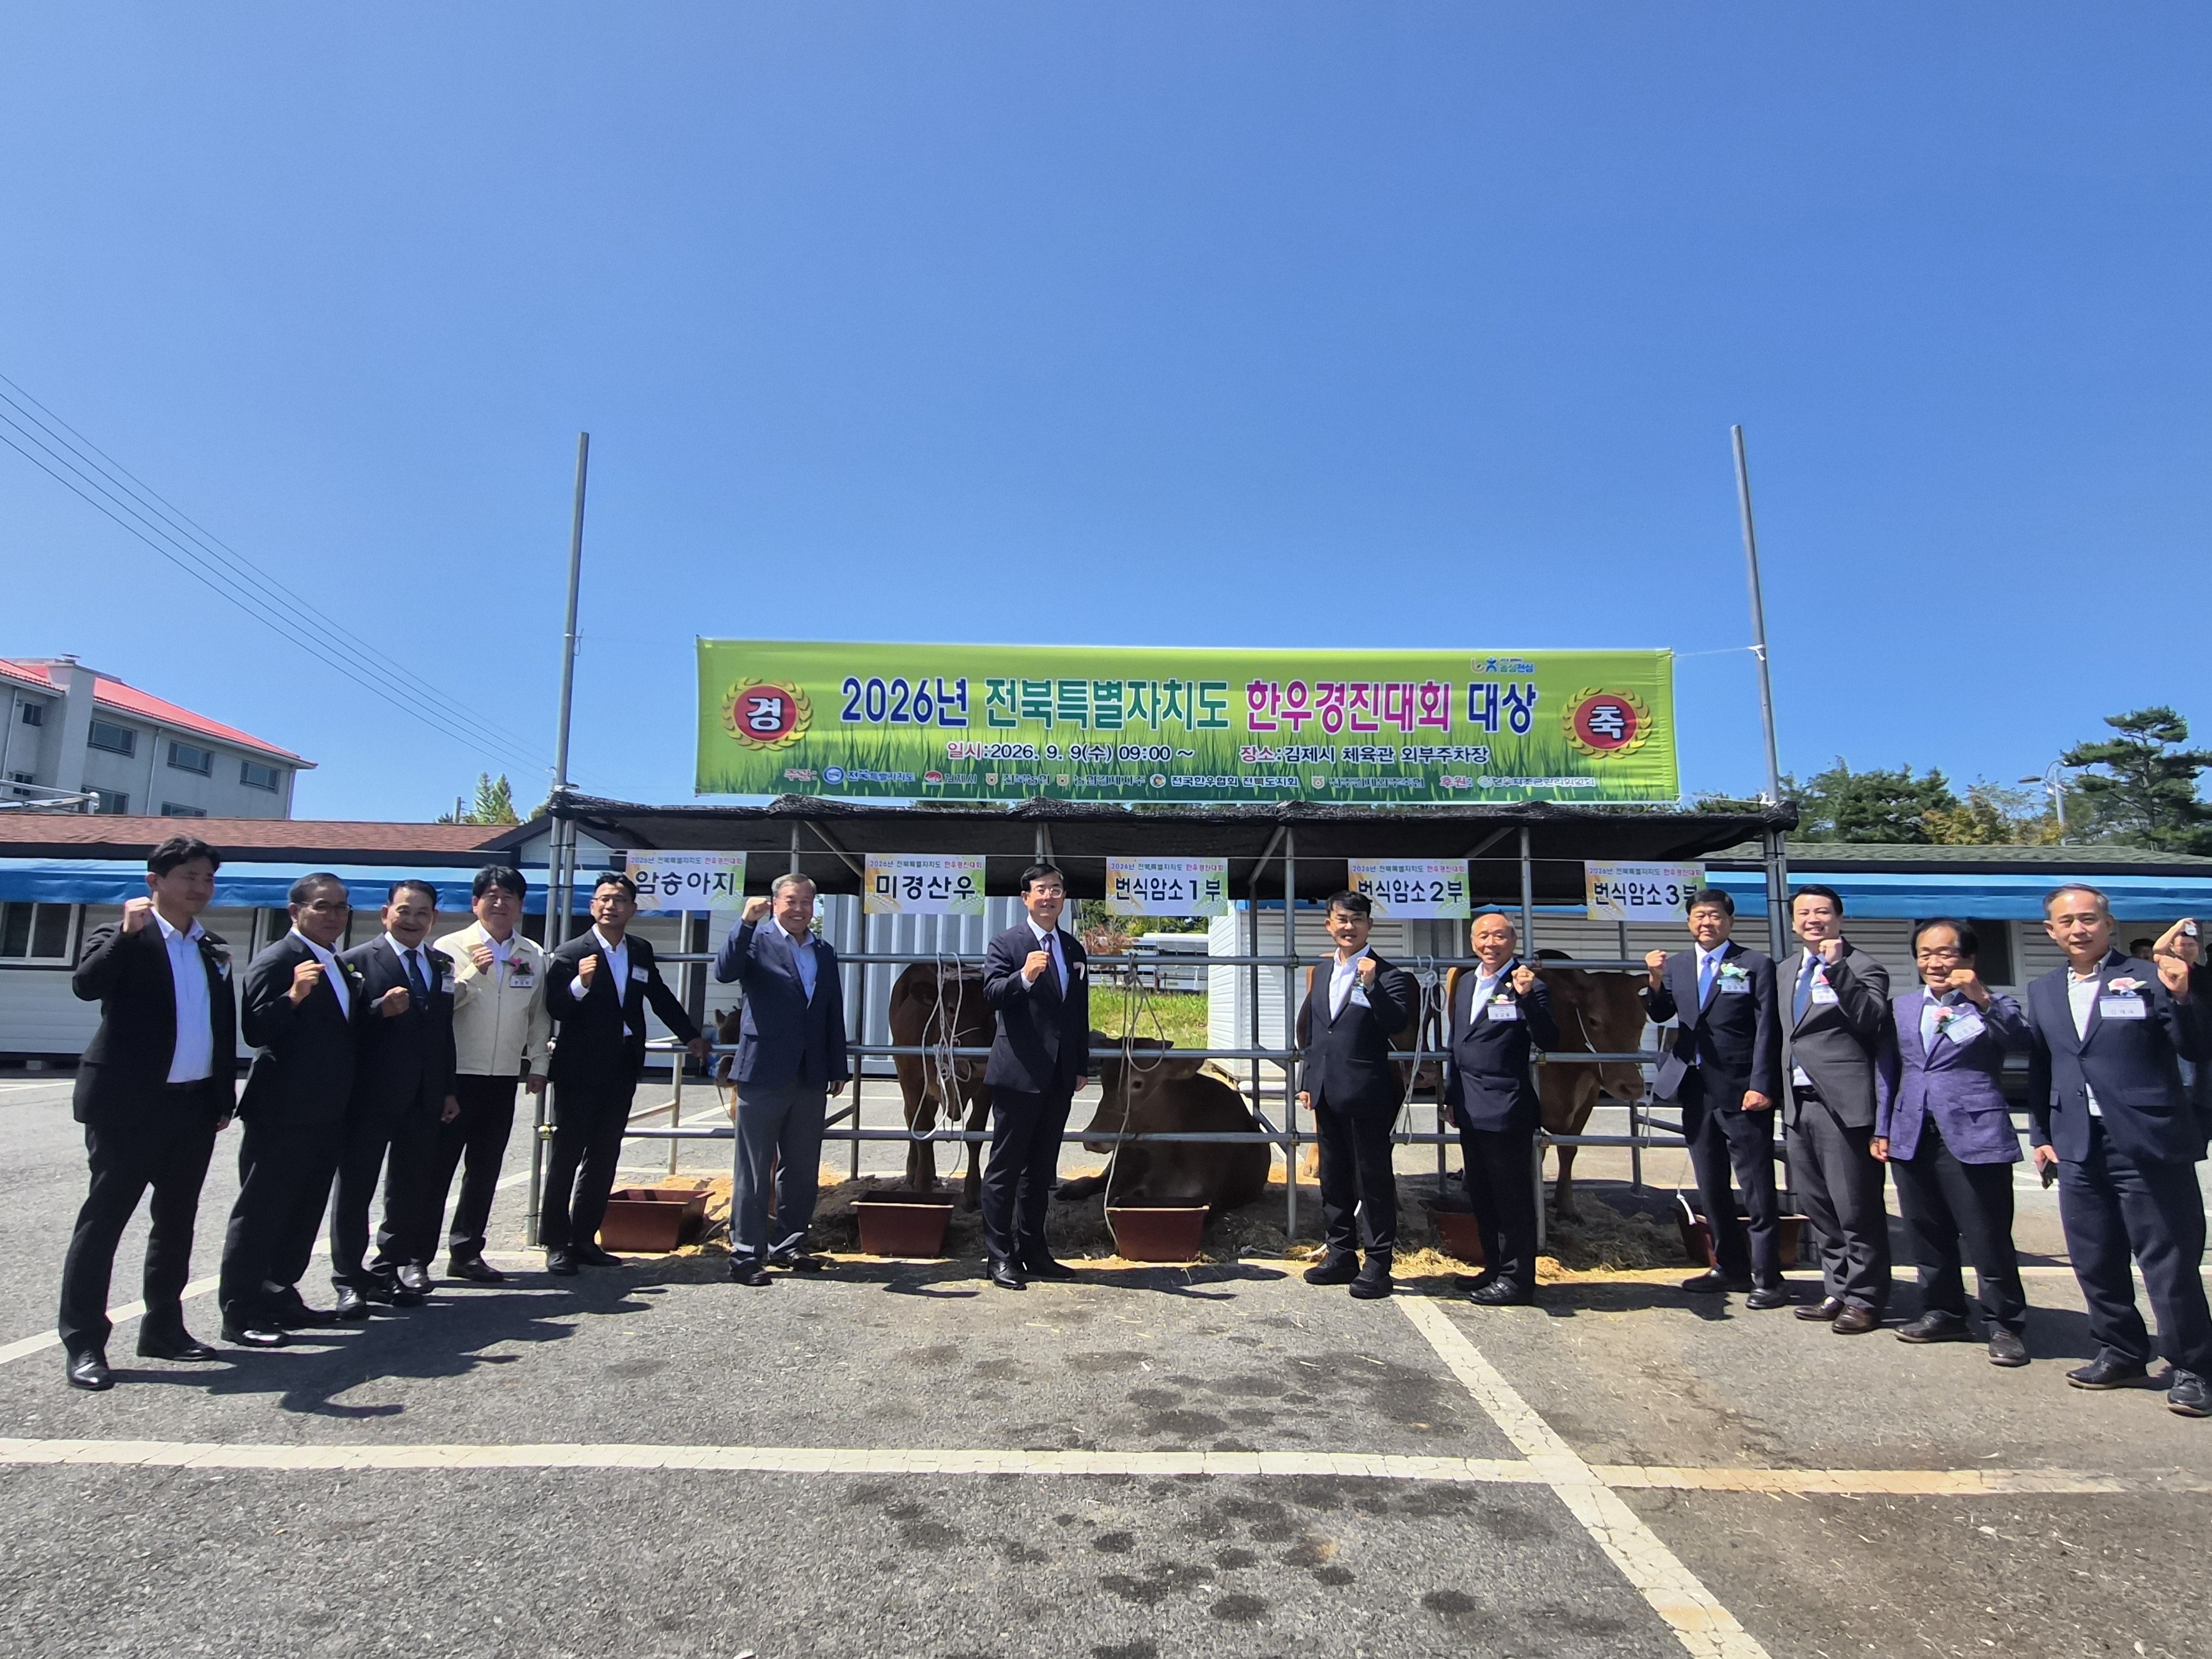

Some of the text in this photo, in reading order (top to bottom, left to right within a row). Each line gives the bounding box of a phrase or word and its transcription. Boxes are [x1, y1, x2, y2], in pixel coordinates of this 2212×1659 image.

[747, 697, 781, 731] 경
[842, 677, 1536, 734] 2026년 전북특별자치도 한우경진대회 대상
[1588, 706, 1625, 739] 축
[1071, 747, 1112, 761] 9(수)
[1119, 747, 1171, 761] 09:00
[1343, 747, 1394, 762] 체육관
[1402, 747, 1488, 763] 외부주차장
[1172, 776, 1238, 786] 전국한우협회
[635, 871, 735, 896] 암송아지
[876, 875, 975, 900] 미경산우
